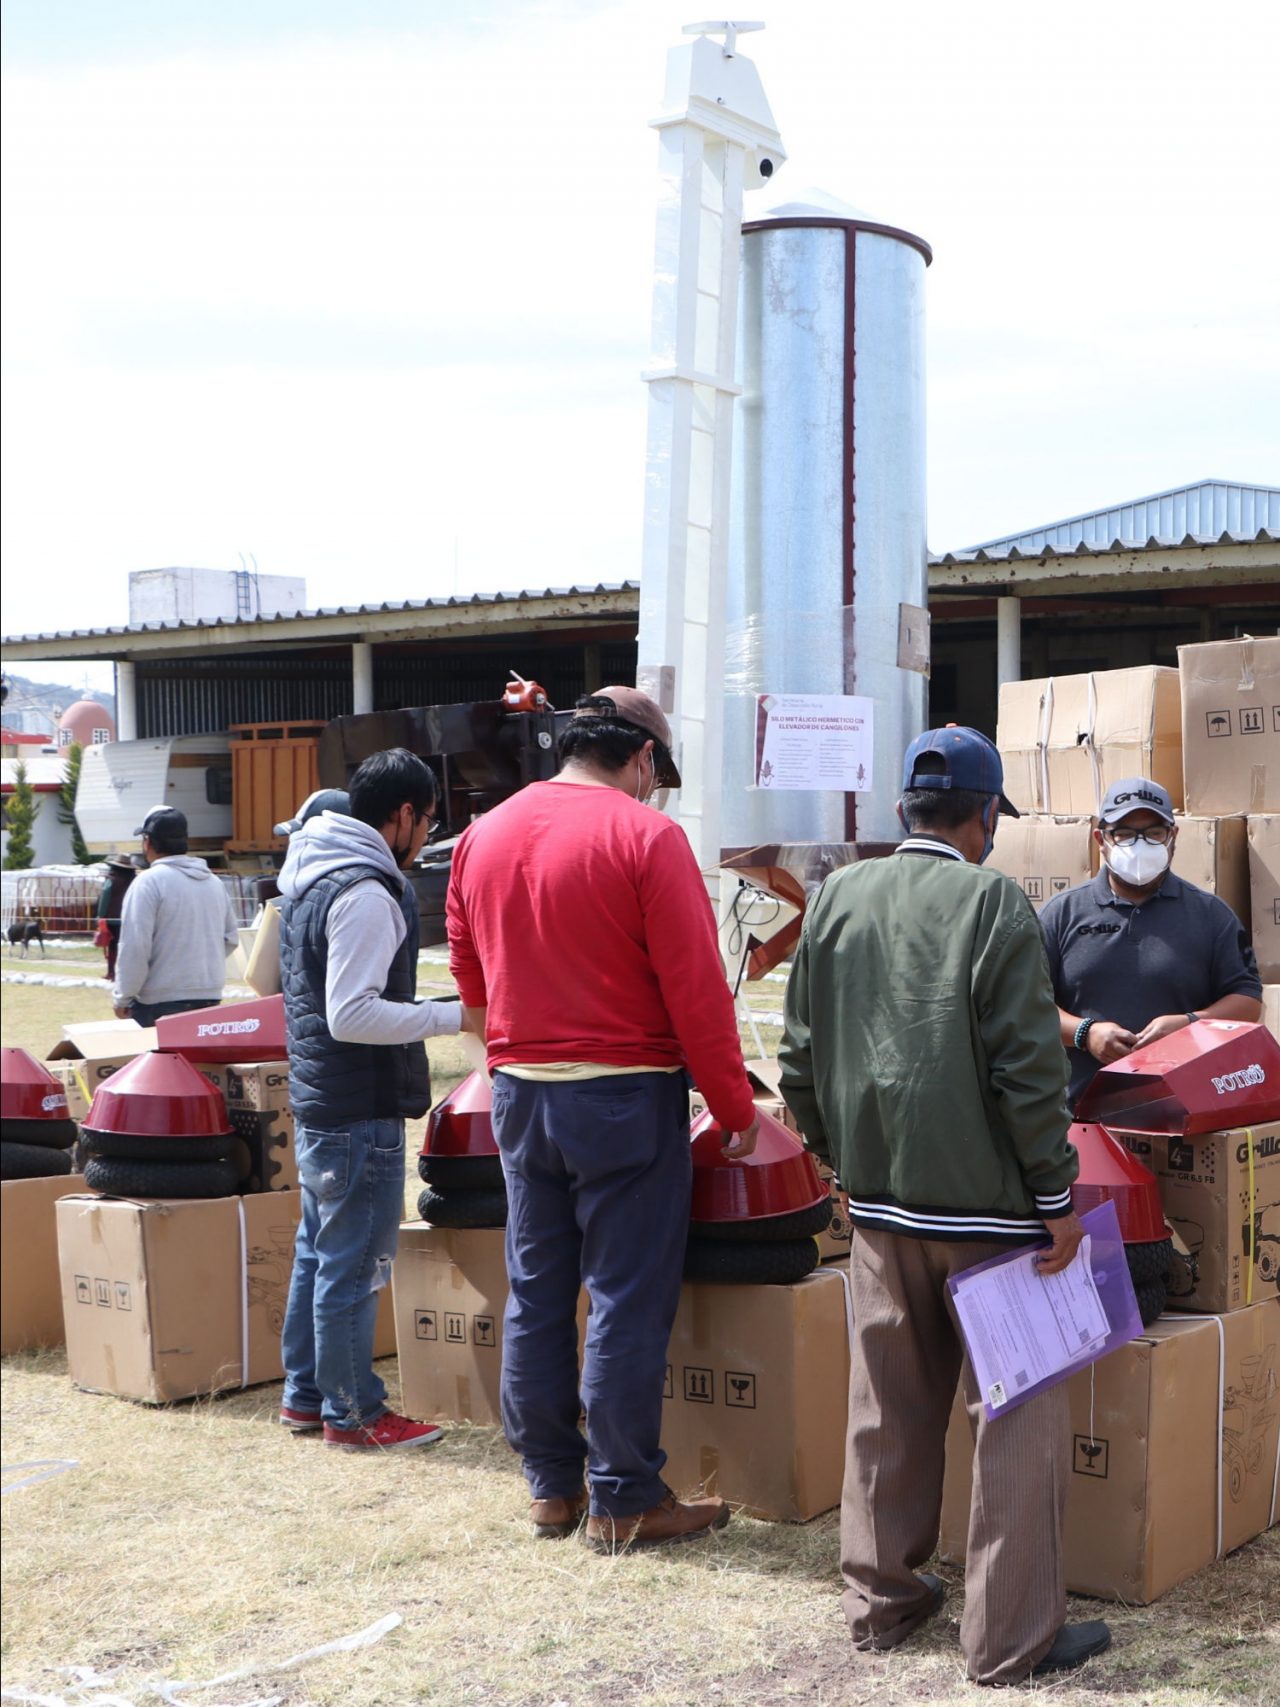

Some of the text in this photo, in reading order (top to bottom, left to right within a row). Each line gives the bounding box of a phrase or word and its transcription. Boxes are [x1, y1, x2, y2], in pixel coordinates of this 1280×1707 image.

[1113, 789, 1164, 806] Grillo
[1170, 1147, 1182, 1167] 4
[1178, 1173, 1189, 1181] GR
[1190, 1175, 1202, 1183] 6.5
[1205, 1176, 1215, 1184] FB
